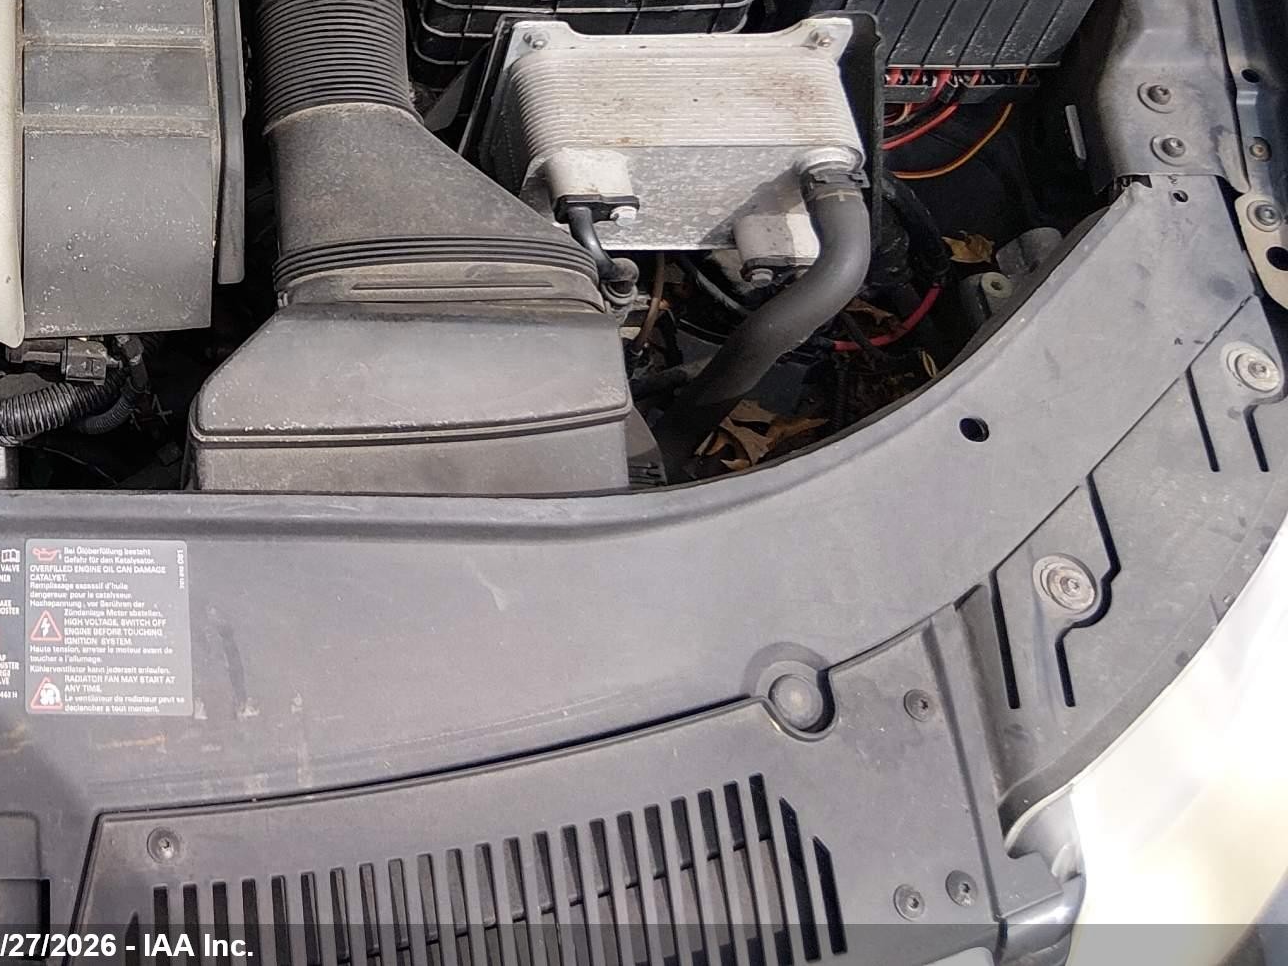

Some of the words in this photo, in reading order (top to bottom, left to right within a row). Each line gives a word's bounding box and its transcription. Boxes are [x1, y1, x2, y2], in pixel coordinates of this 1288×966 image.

[30, 565, 72, 574] OVERFILLED
[74, 565, 102, 574] ENGINE
[104, 565, 115, 574] OIL
[116, 565, 132, 574] CAN
[134, 565, 166, 574] DAMAGE
[64, 618, 83, 626] HIGH
[121, 618, 151, 626] SWITCH
[152, 618, 167, 626] OFF
[64, 628, 92, 636] ENGINE
[94, 628, 122, 636] BEFORE
[124, 628, 162, 636] TOUCHING
[64, 637, 98, 645] IGNITION
[64, 684, 80, 692] ANY
